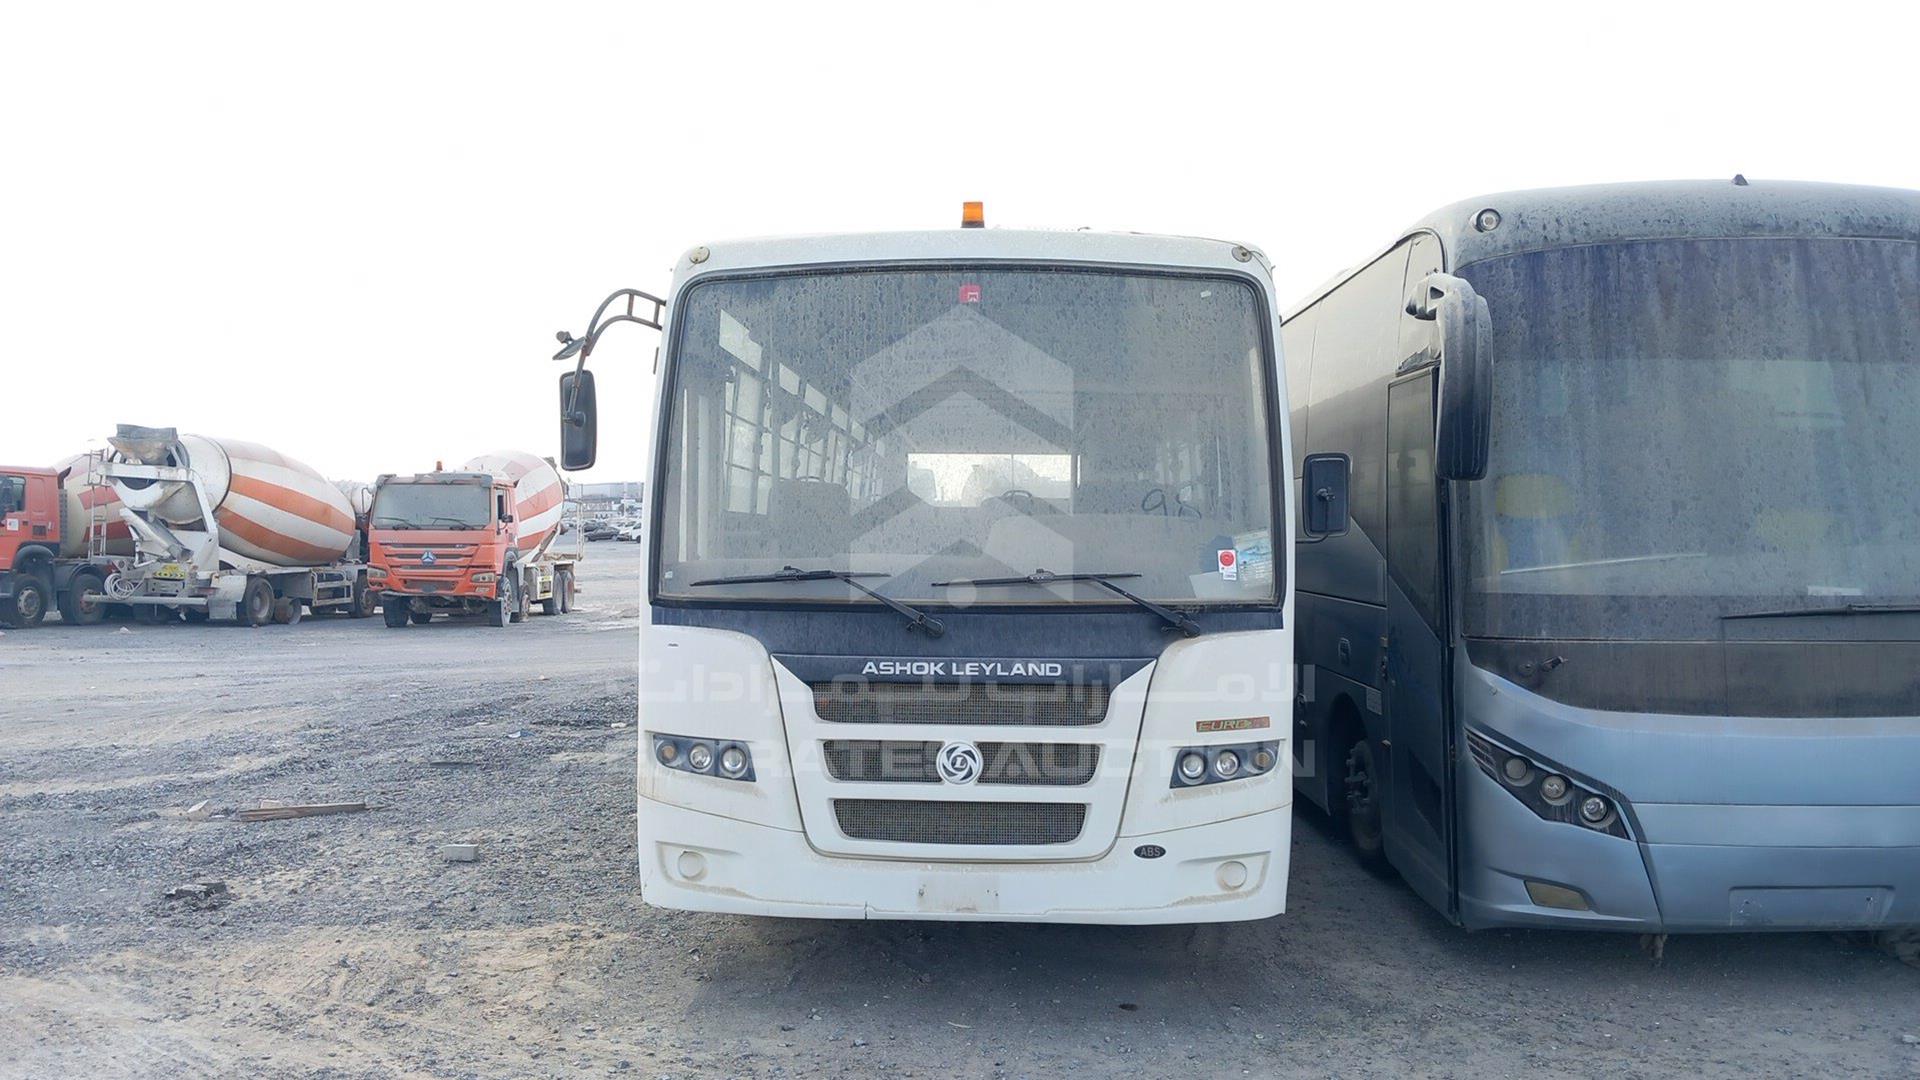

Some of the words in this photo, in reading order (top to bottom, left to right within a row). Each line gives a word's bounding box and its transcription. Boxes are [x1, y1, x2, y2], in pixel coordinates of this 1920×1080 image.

[862, 661, 945, 675] ASHOK
[951, 662, 1062, 676] LEYLAND
[1140, 846, 1161, 857] ABS
